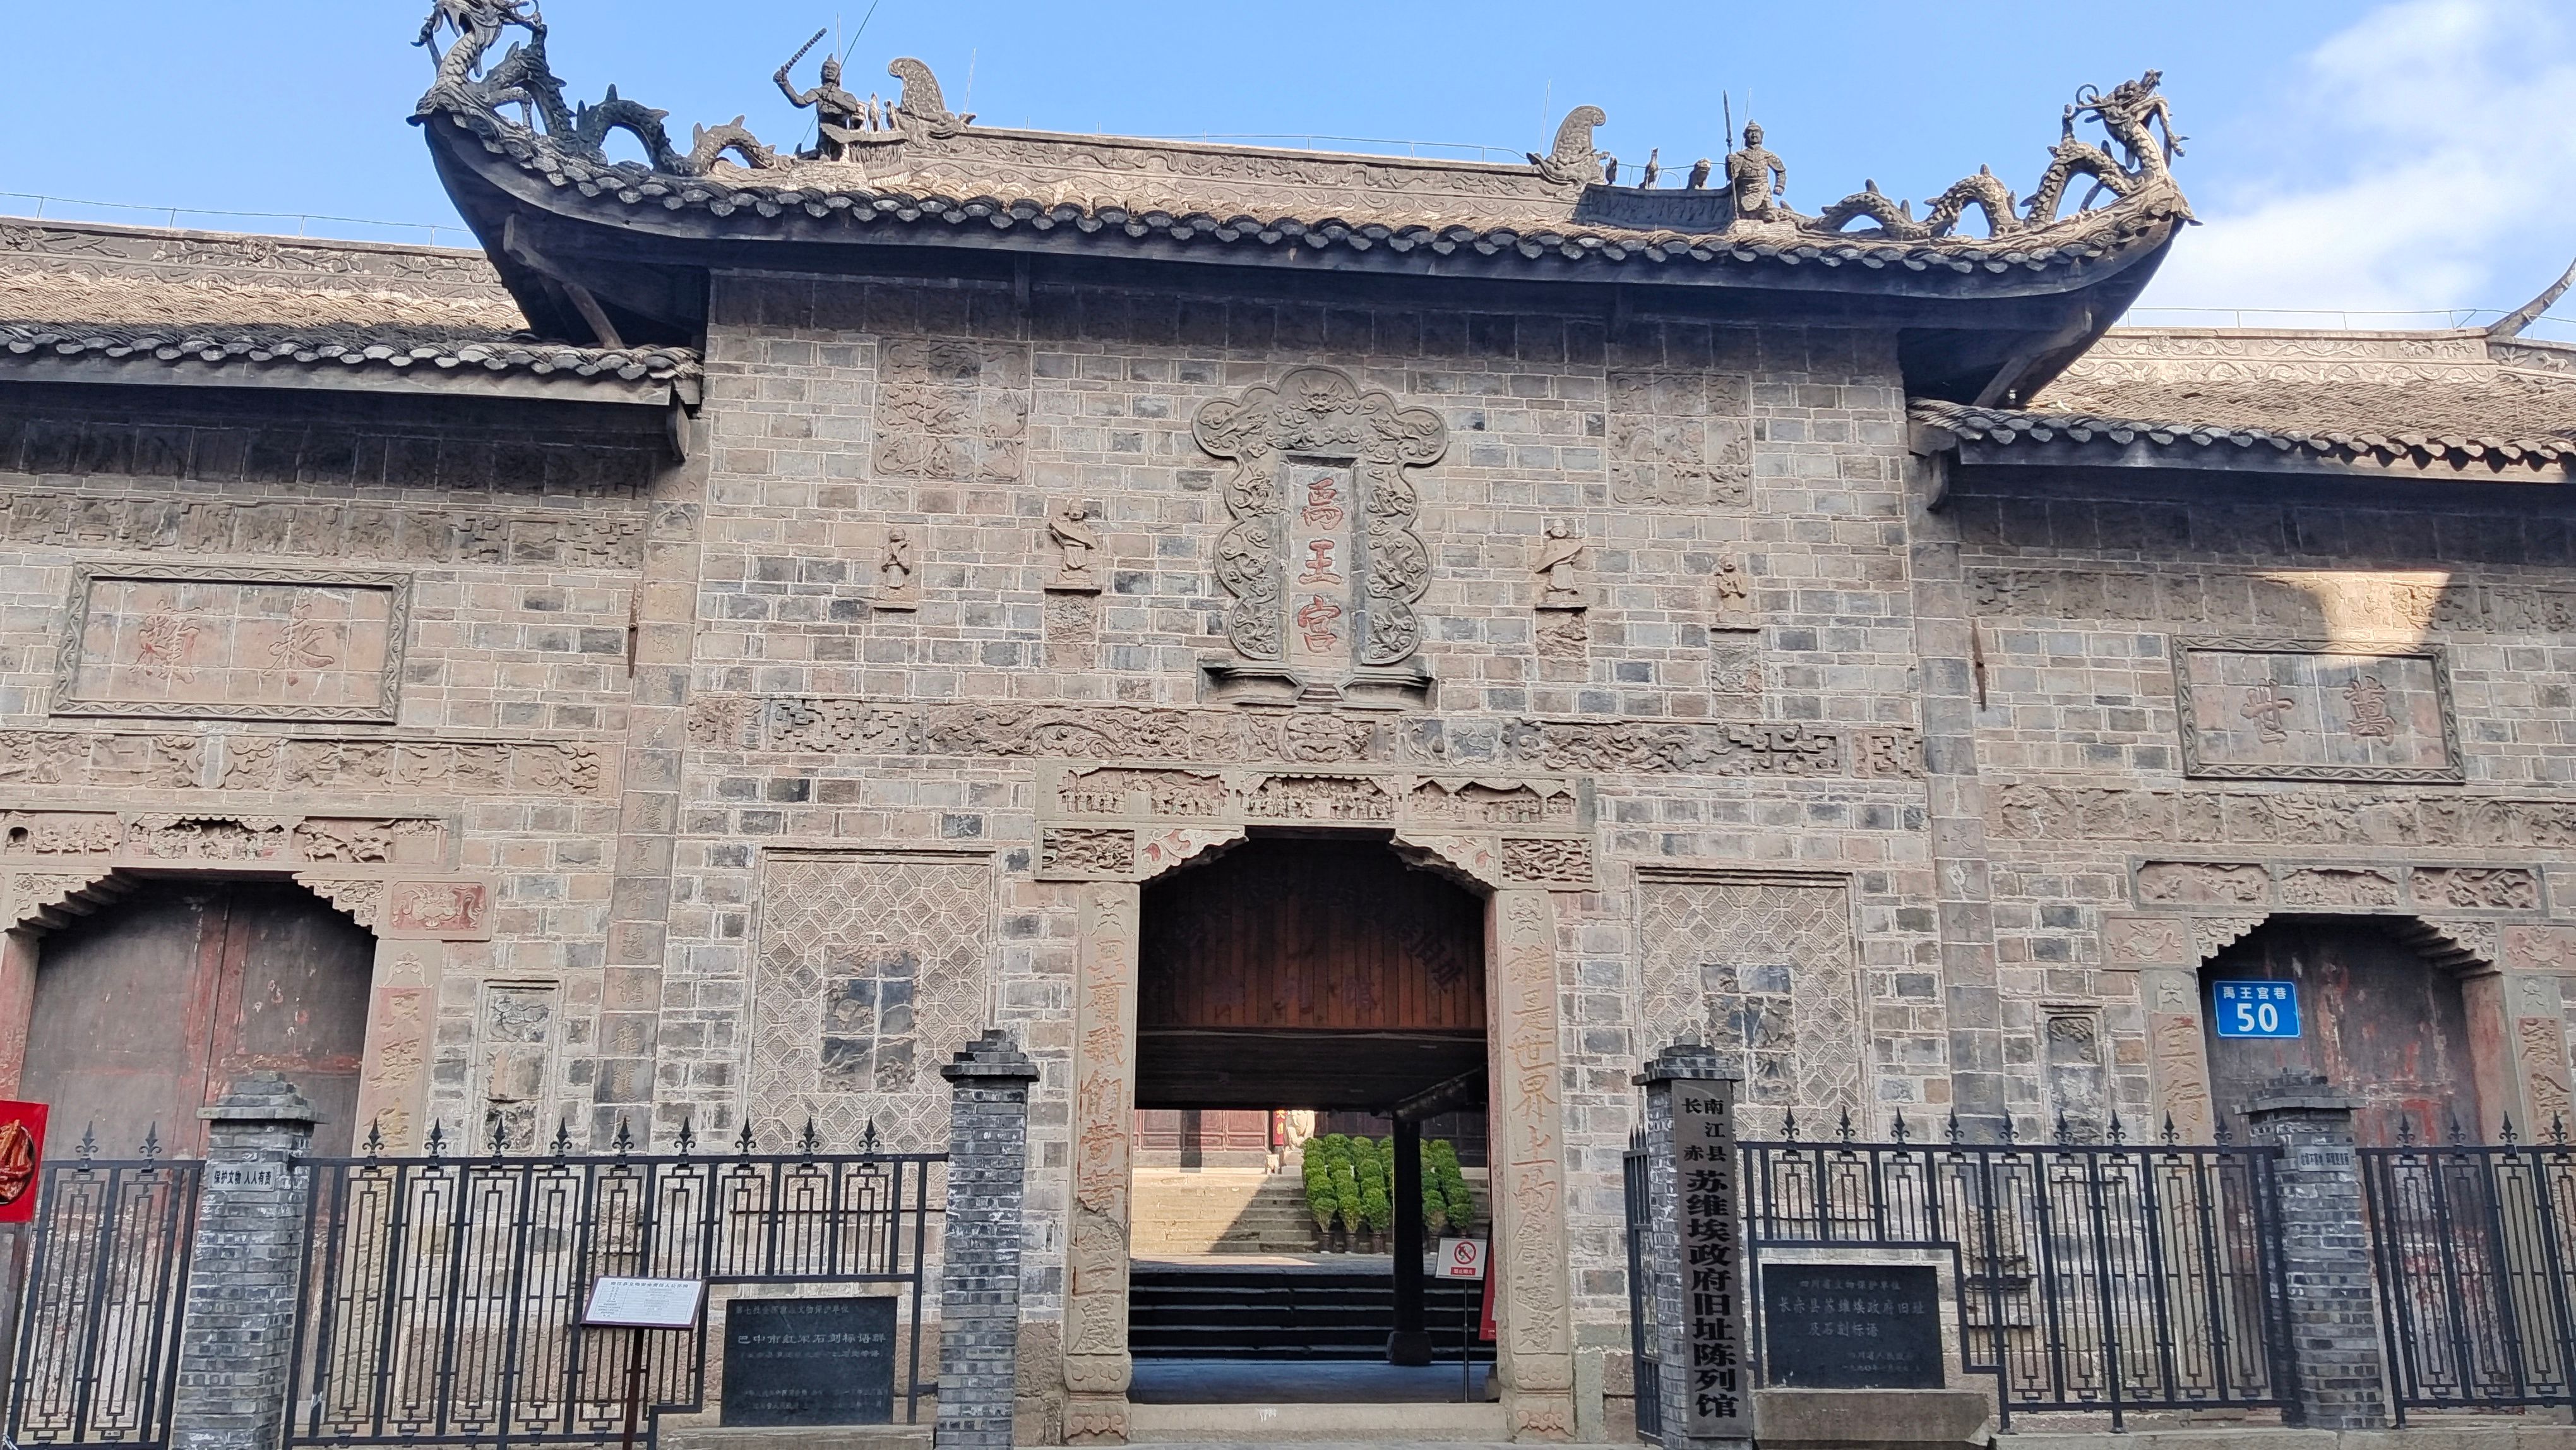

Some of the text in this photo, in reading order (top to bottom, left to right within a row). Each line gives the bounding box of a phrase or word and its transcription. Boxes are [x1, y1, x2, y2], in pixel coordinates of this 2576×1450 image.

[2222, 986, 2286, 1000] 禹王宫巷
[2237, 1002, 2278, 1033] 50
[1703, 1098, 1727, 1163] 南江县
[214, 1170, 272, 1185] 保护文物 人人有责
[1685, 1170, 1739, 1418] 苏维埃政府旧址陈列馆
[1778, 1296, 1925, 1315] 长赤县苏维埃政府旧址
[1808, 1321, 1879, 1338] 及石刻标语
